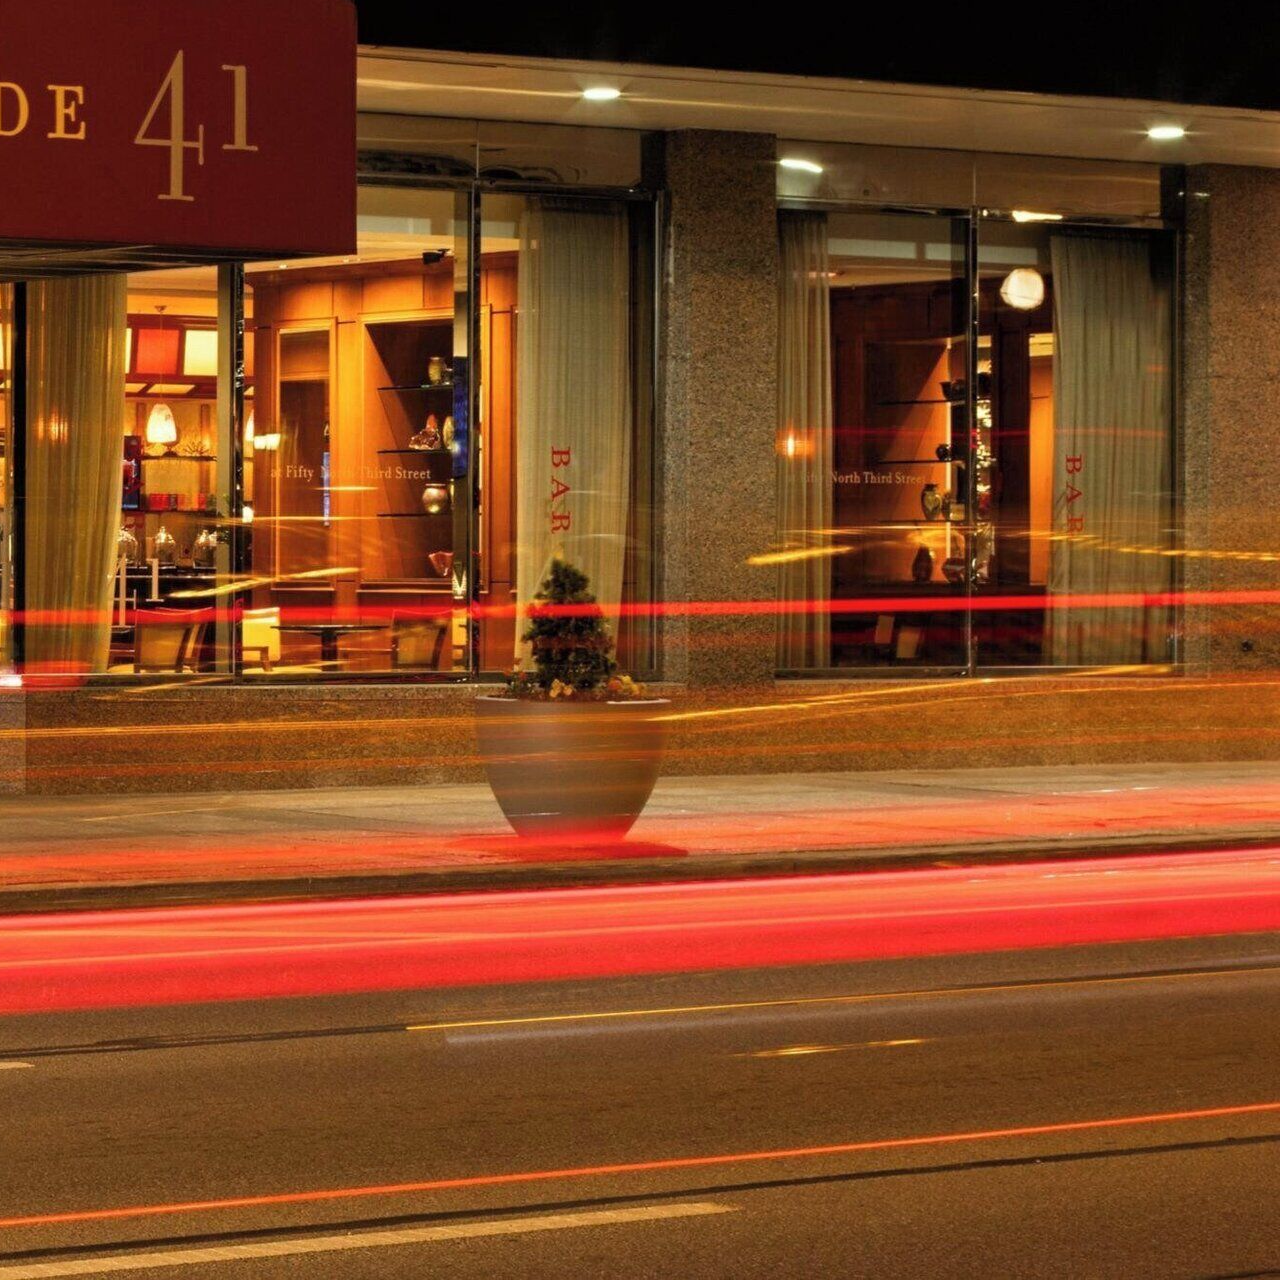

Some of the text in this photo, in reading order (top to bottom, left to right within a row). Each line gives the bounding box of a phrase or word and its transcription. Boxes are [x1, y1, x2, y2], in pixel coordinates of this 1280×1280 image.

[134, 49, 260, 202] 41
[286, 465, 315, 483] Fifty
[359, 465, 392, 479] Third
[395, 466, 433, 479] Street
[551, 445, 572, 535] BAR
[831, 471, 861, 484] North
[863, 471, 893, 484] Third
[1065, 454, 1085, 538] BAR
